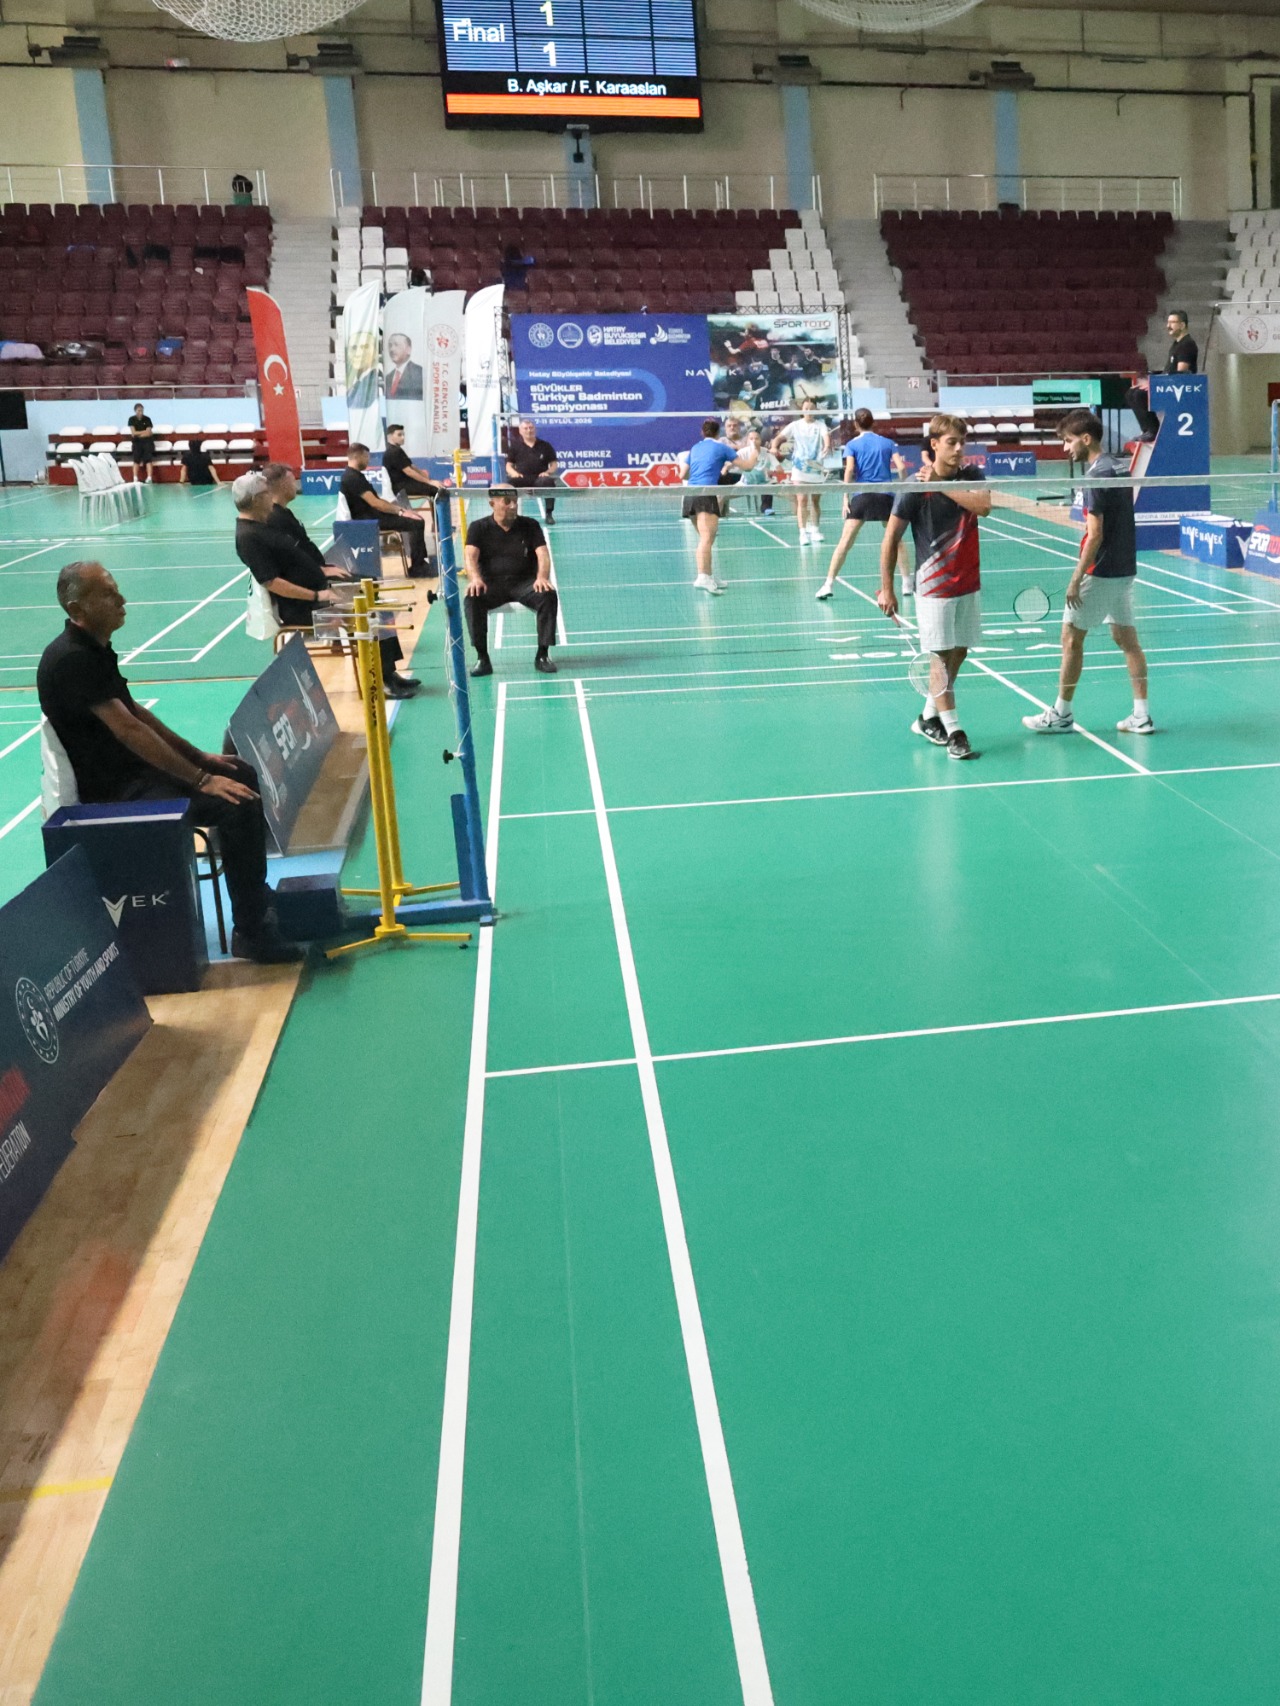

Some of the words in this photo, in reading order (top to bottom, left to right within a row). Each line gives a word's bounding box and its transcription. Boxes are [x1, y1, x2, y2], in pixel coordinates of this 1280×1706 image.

[453, 20, 506, 42] Final
[543, 41, 557, 67] 1
[507, 79, 523, 93] B.
[527, 79, 568, 96] Aşkar
[580, 80, 593, 94] F.
[432, 361, 440, 385] SPOR
[530, 383, 583, 392] BÜYÜKLER
[1156, 384, 1202, 402] NAVEK
[530, 392, 575, 403] Türkiye
[578, 392, 643, 401] Badminton
[531, 402, 608, 413] Şampiyonası
[1177, 412, 1194, 436] 2
[555, 450, 574, 459] KYA
[575, 450, 611, 459] MERKEZ
[568, 460, 604, 469] SALONU
[995, 457, 1032, 470] NAVEK
[306, 475, 342, 490] NAVE
[621, 472, 631, 485] 2
[1182, 525, 1198, 550] NAVE
[351, 546, 374, 560] VEK
[101, 892, 169, 929] VEK
[80, 965, 97, 992] YOUTH
[102, 941, 119, 968] SPORTS
[0, 1119, 32, 1183] EDERATION
